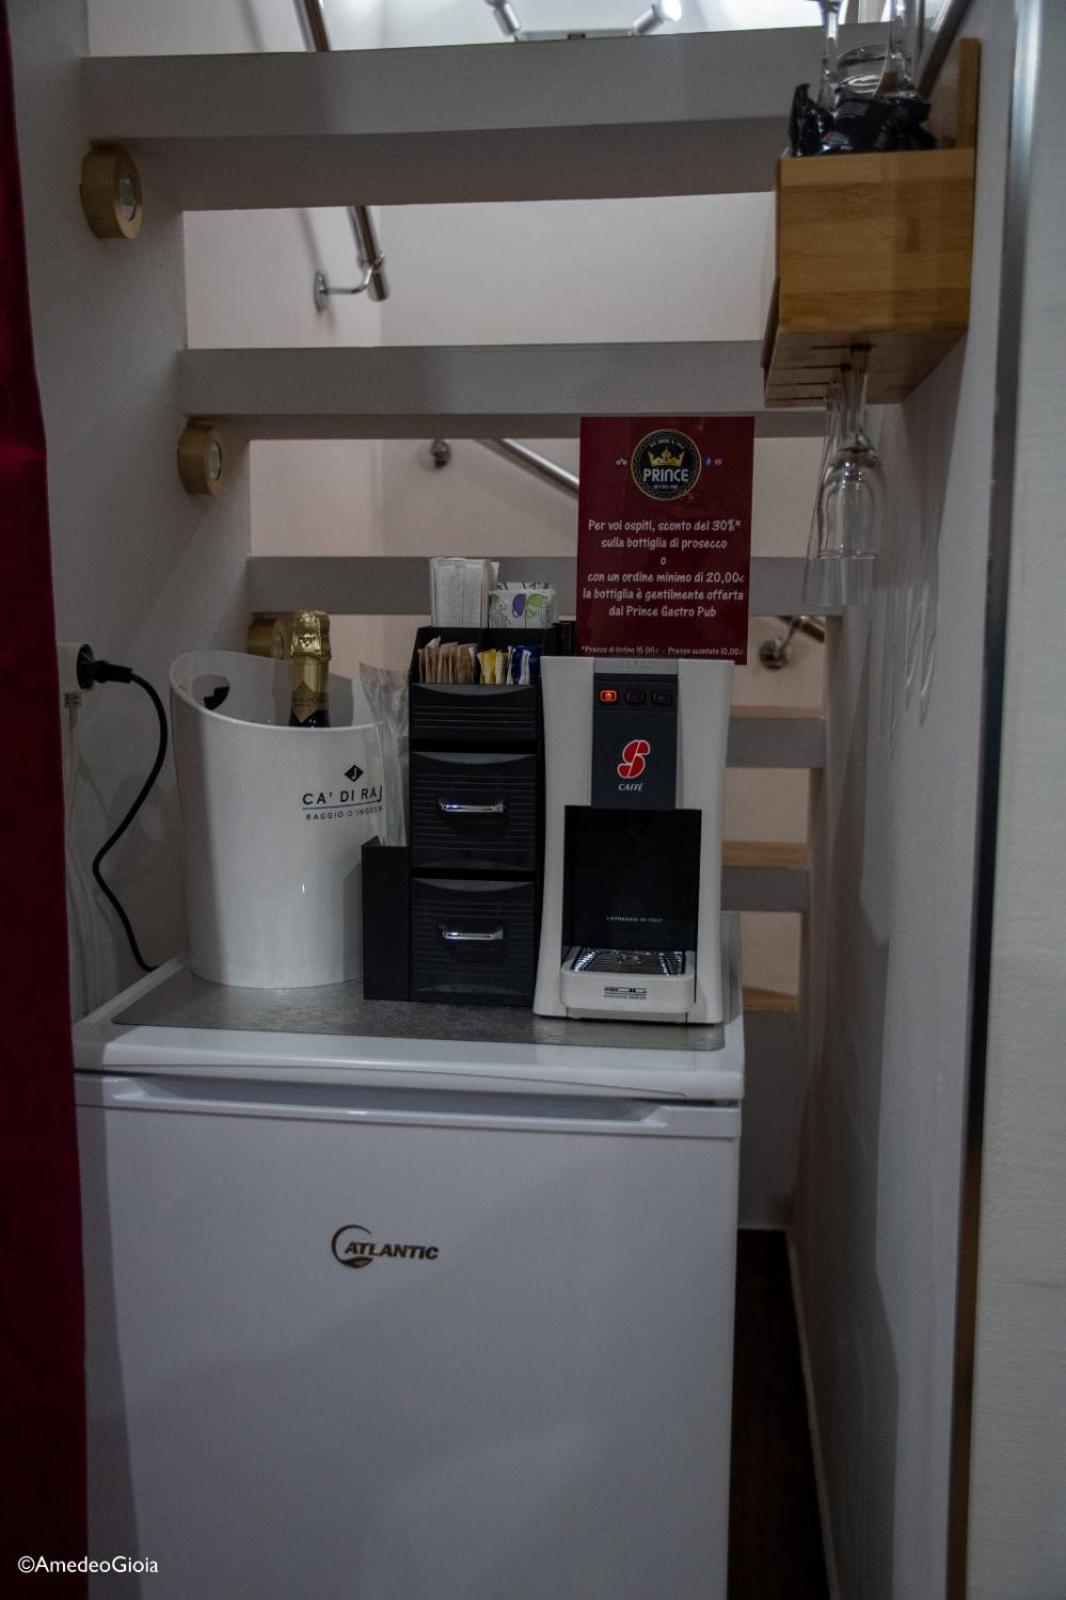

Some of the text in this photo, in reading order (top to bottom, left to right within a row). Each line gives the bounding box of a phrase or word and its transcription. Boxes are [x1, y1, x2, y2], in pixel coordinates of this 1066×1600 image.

[642, 468, 689, 483] PRINCE
[588, 519, 606, 532] Per
[607, 520, 623, 532] voi
[624, 520, 656, 534] ospiti,
[657, 521, 692, 532] sconto
[694, 519, 710, 532] del
[600, 537, 728, 552] sulla bottiglia di prosecco
[659, 557, 667, 566] o
[587, 573, 604, 583] con
[607, 573, 620, 583] un
[622, 571, 654, 583] ordine
[656, 571, 692, 584] minimo
[694, 572, 704, 584] di
[582, 588, 591, 599] la
[594, 588, 634, 602] bottiglia
[645, 588, 705, 602] gentilmente
[706, 588, 744, 600] offerta
[608, 605, 717, 618] dal Prince Gastro Pub
[302, 792, 332, 805] CA'
[340, 790, 355, 803] DI
[306, 811, 344, 820] RAGGIO
[344, 1241, 439, 1260] ATLANTIC
